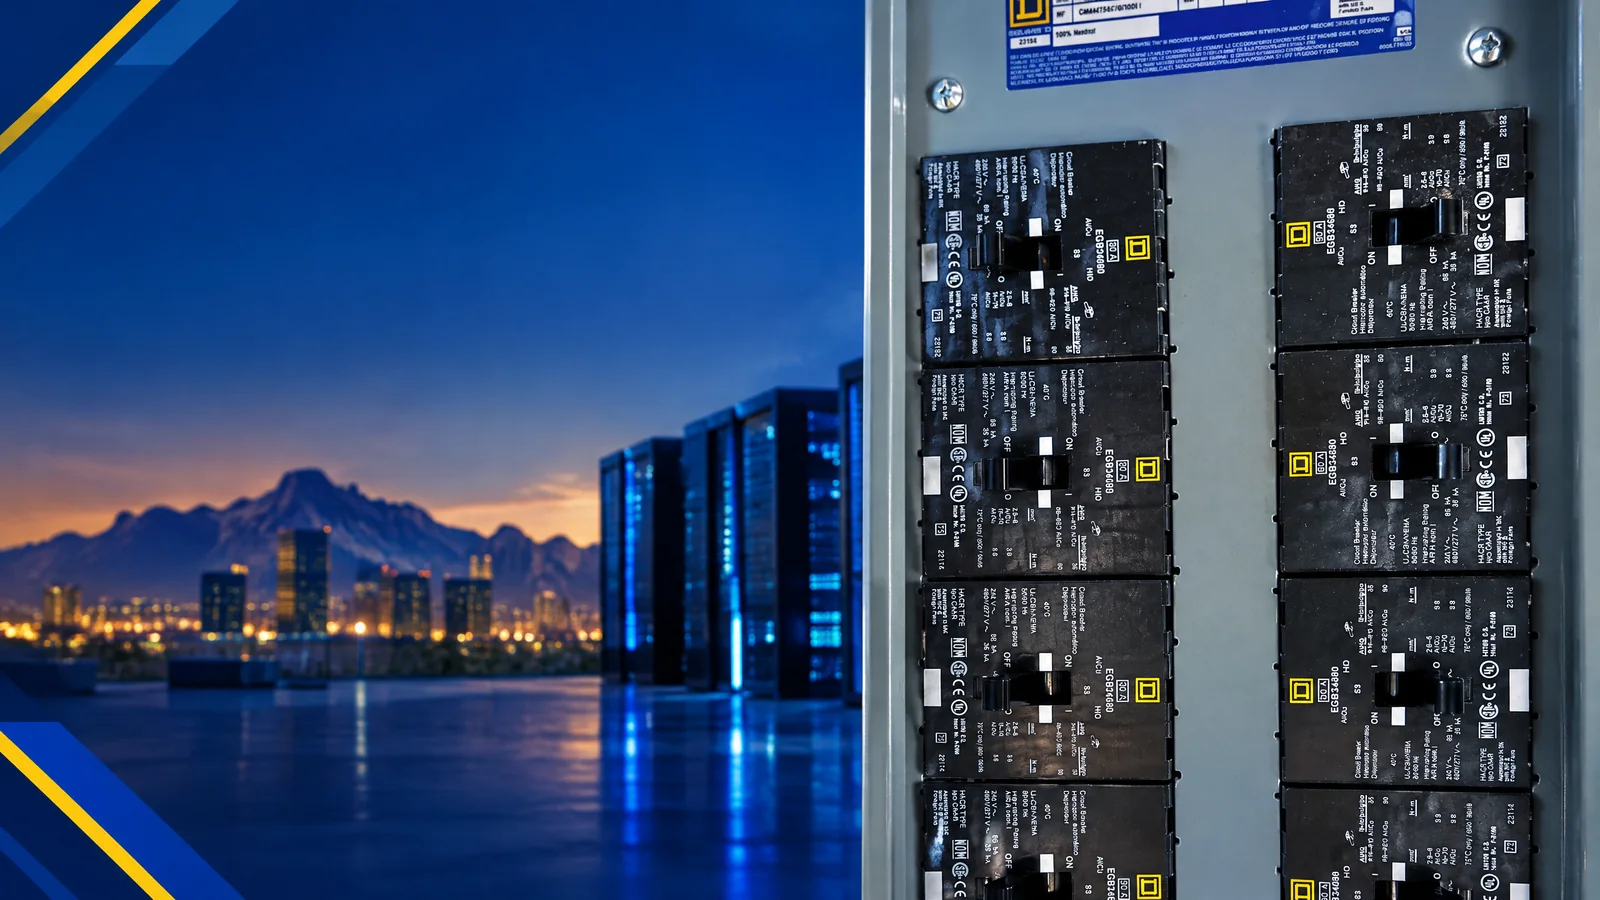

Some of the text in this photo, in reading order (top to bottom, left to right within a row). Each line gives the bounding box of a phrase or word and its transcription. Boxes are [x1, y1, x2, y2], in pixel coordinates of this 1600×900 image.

[948, 211, 961, 231] NOM
[1054, 219, 1062, 231] ON
[1368, 251, 1376, 265] ON
[1429, 247, 1438, 263] OFF
[1476, 254, 1490, 275] NOM
[952, 424, 965, 444] NOM
[1003, 436, 1011, 453] OFF
[1065, 437, 1073, 450] ON
[1370, 484, 1377, 497] ON
[953, 638, 965, 658] NOM
[1003, 652, 1011, 668] OFF
[1065, 655, 1072, 667] ON
[1371, 712, 1378, 724] ON
[1480, 722, 1495, 738] NOM
[954, 840, 966, 859] NOM
[1066, 856, 1073, 868] ON
